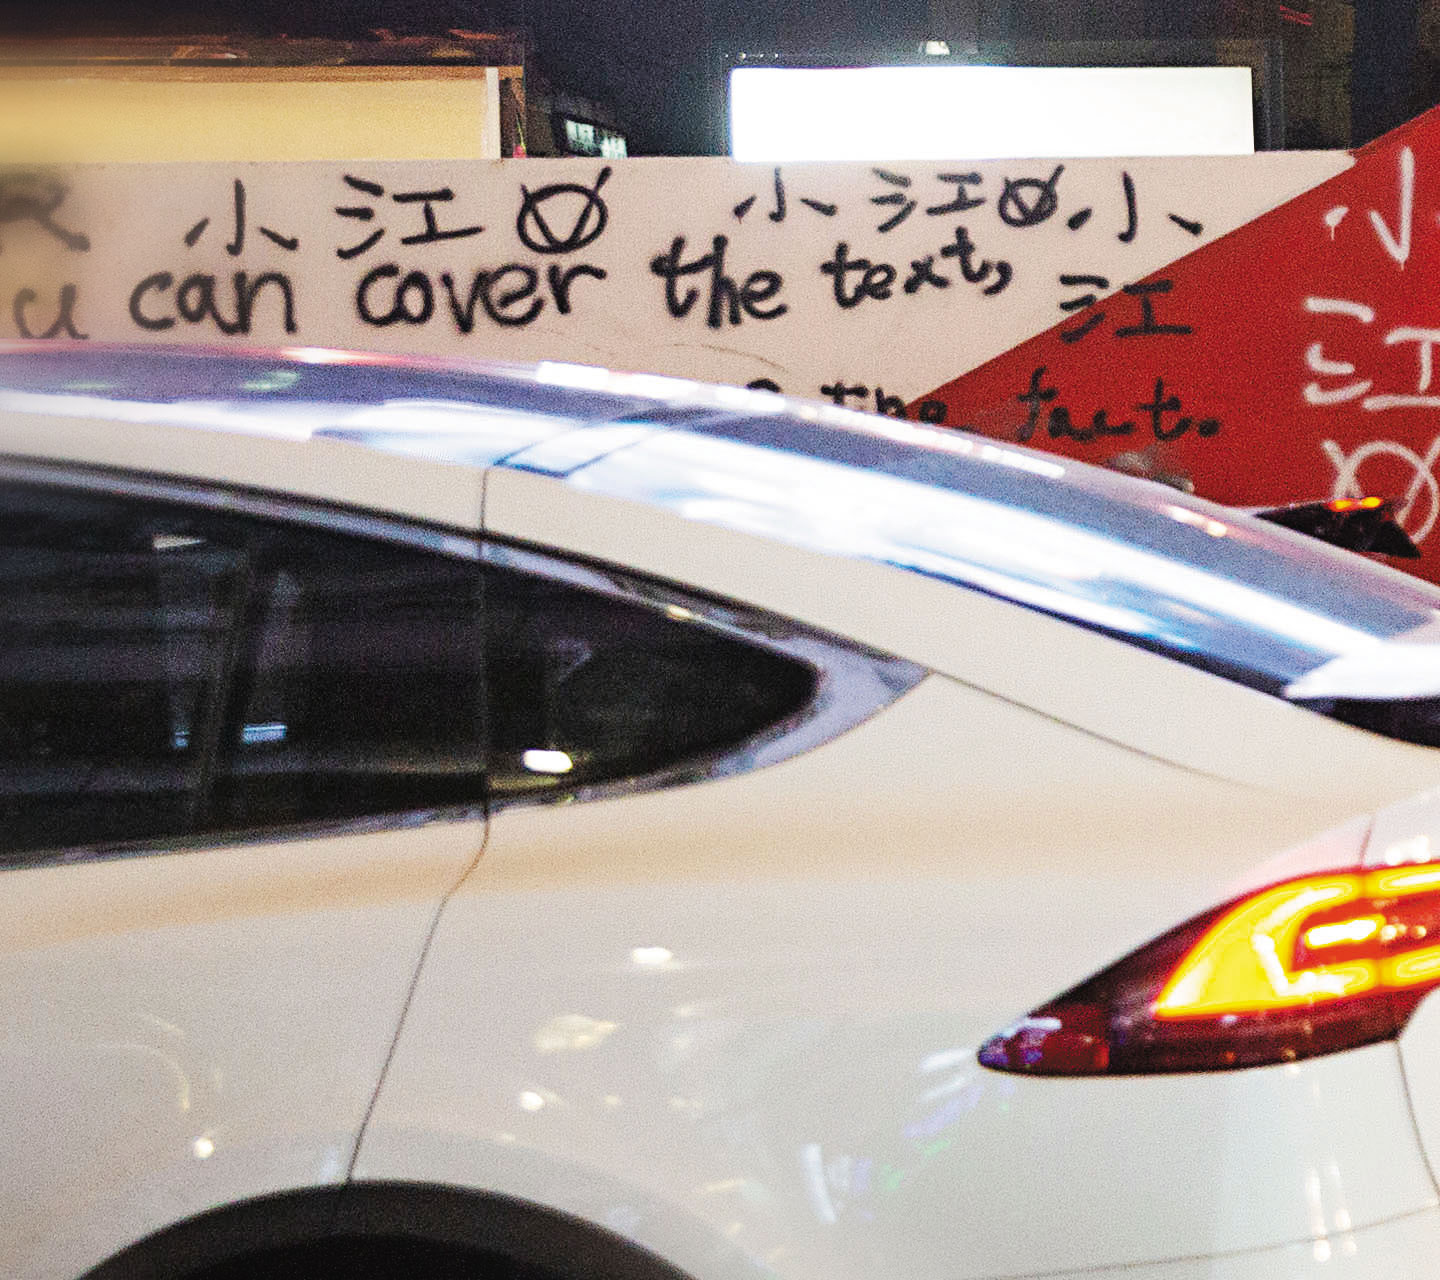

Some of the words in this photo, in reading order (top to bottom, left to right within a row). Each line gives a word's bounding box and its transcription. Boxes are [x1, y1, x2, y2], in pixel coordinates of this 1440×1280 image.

[128, 266, 299, 335] can
[355, 258, 607, 334] cover
[651, 234, 788, 329] the
